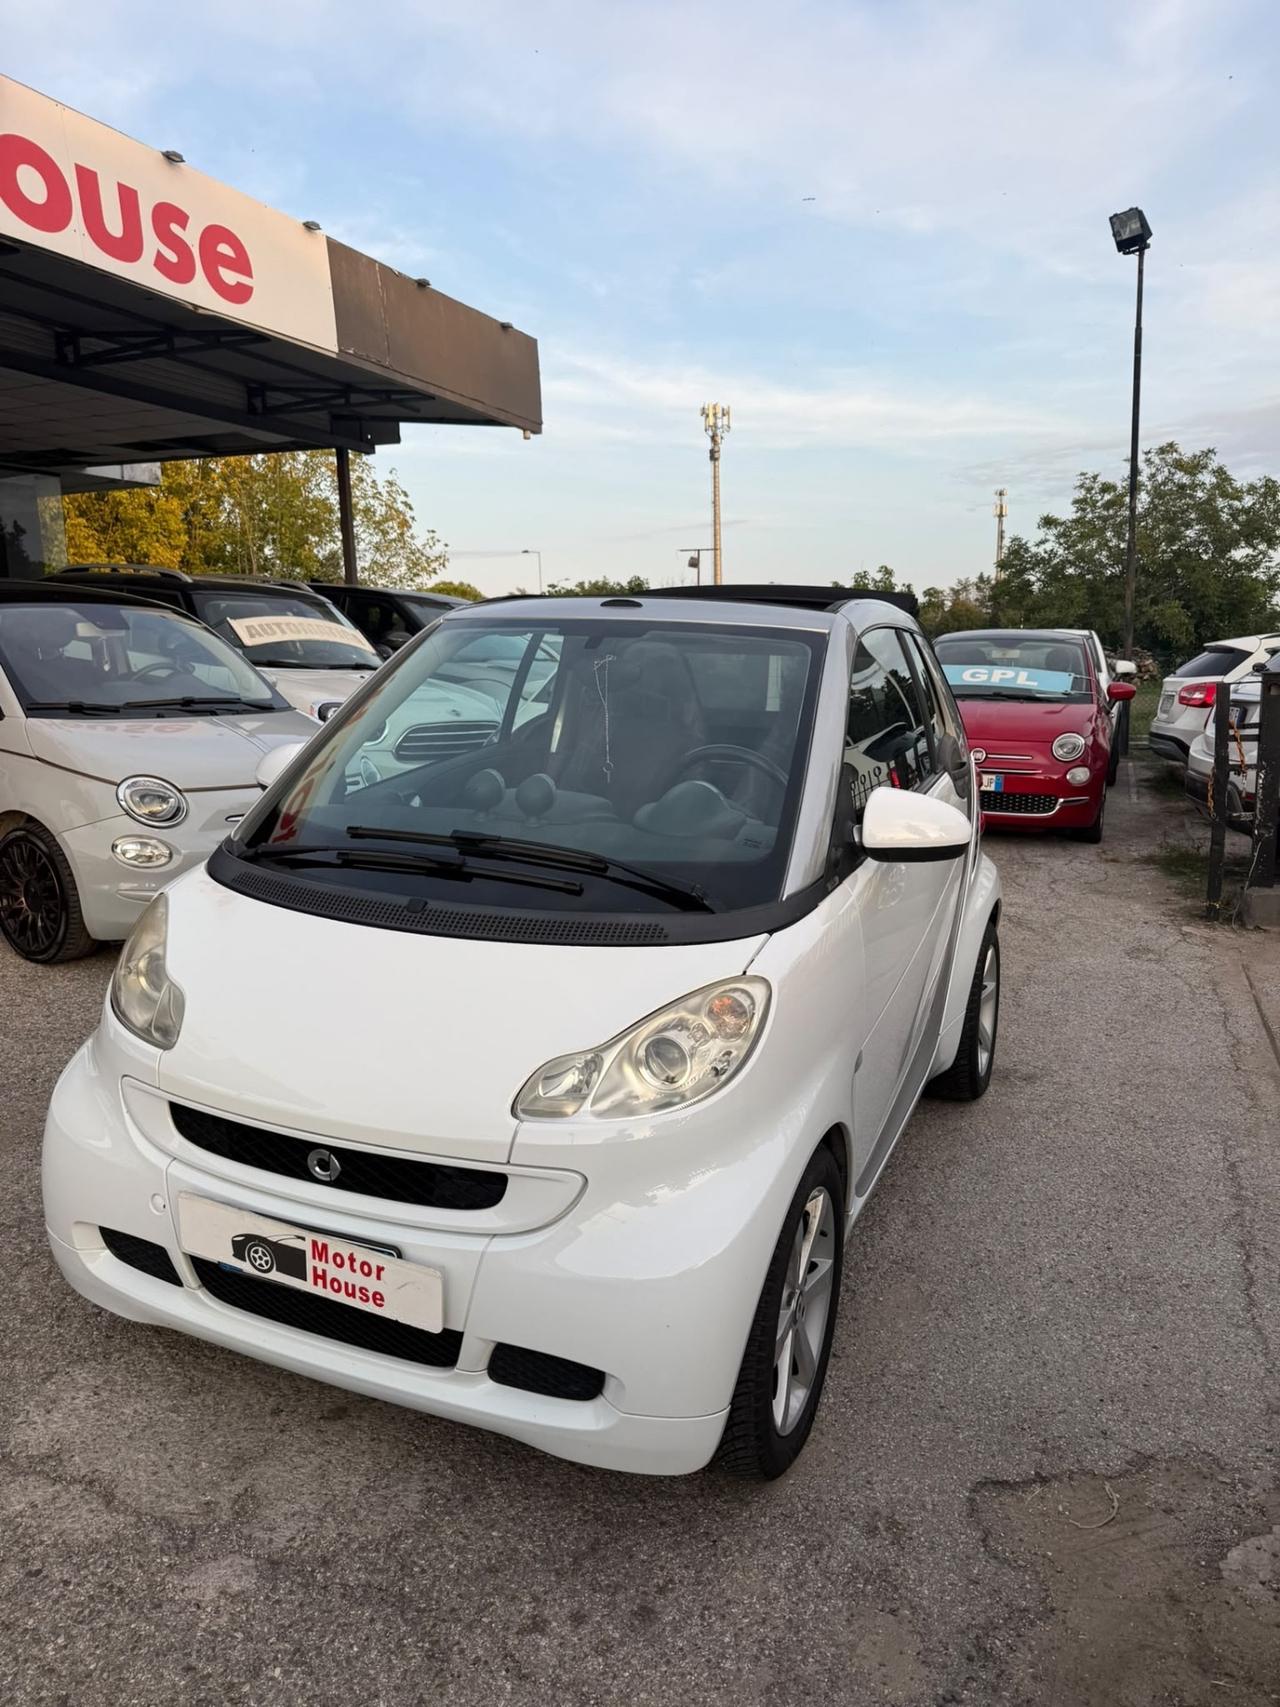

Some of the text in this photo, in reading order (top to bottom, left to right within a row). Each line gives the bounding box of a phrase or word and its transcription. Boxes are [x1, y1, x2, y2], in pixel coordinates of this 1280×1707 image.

[961, 668, 1038, 687] GPL
[311, 1239, 386, 1281] Motor
[312, 1265, 386, 1308] House
